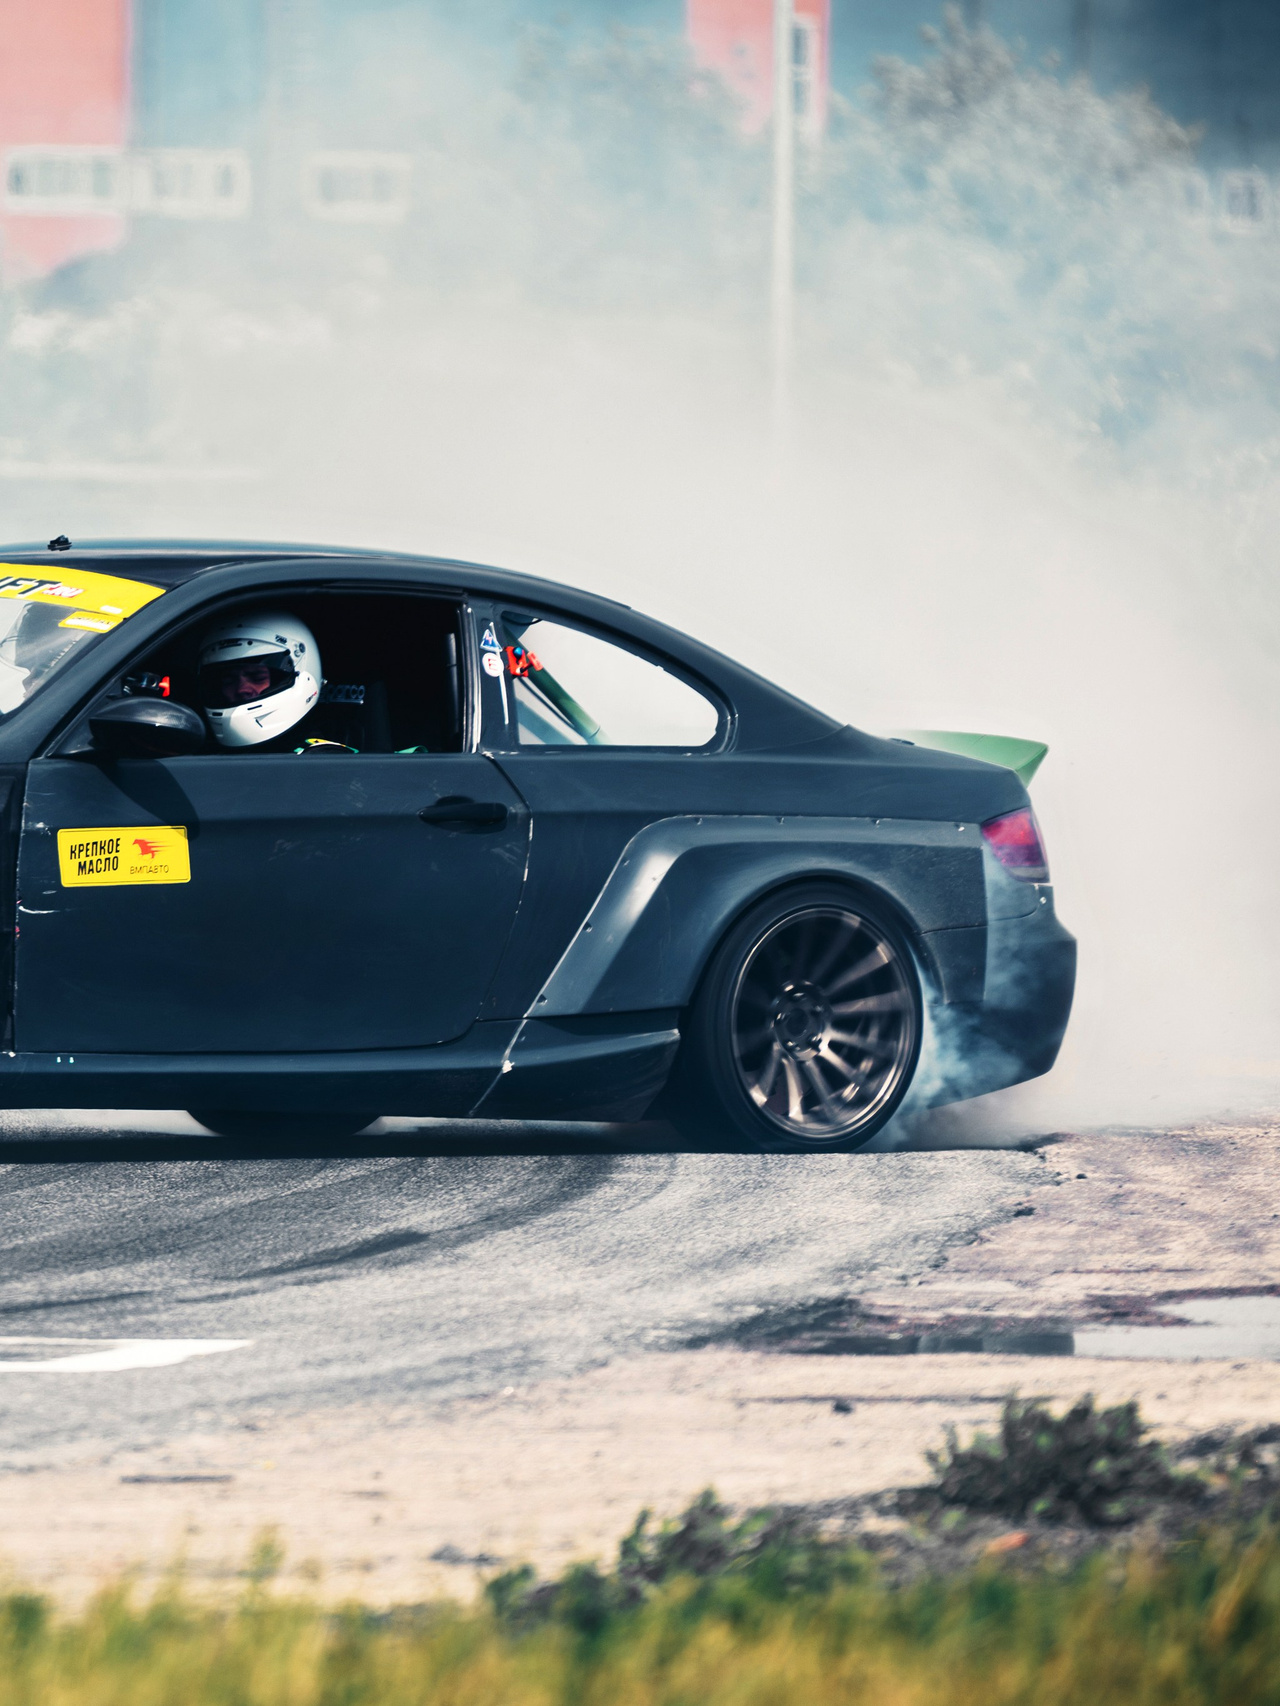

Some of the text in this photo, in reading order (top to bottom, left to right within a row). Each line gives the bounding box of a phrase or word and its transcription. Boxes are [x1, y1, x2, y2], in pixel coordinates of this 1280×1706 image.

[70, 838, 121, 860] КРЕПКОЕ
[78, 856, 119, 876] МАСЛО
[130, 864, 169, 874] ВМПАВТО
